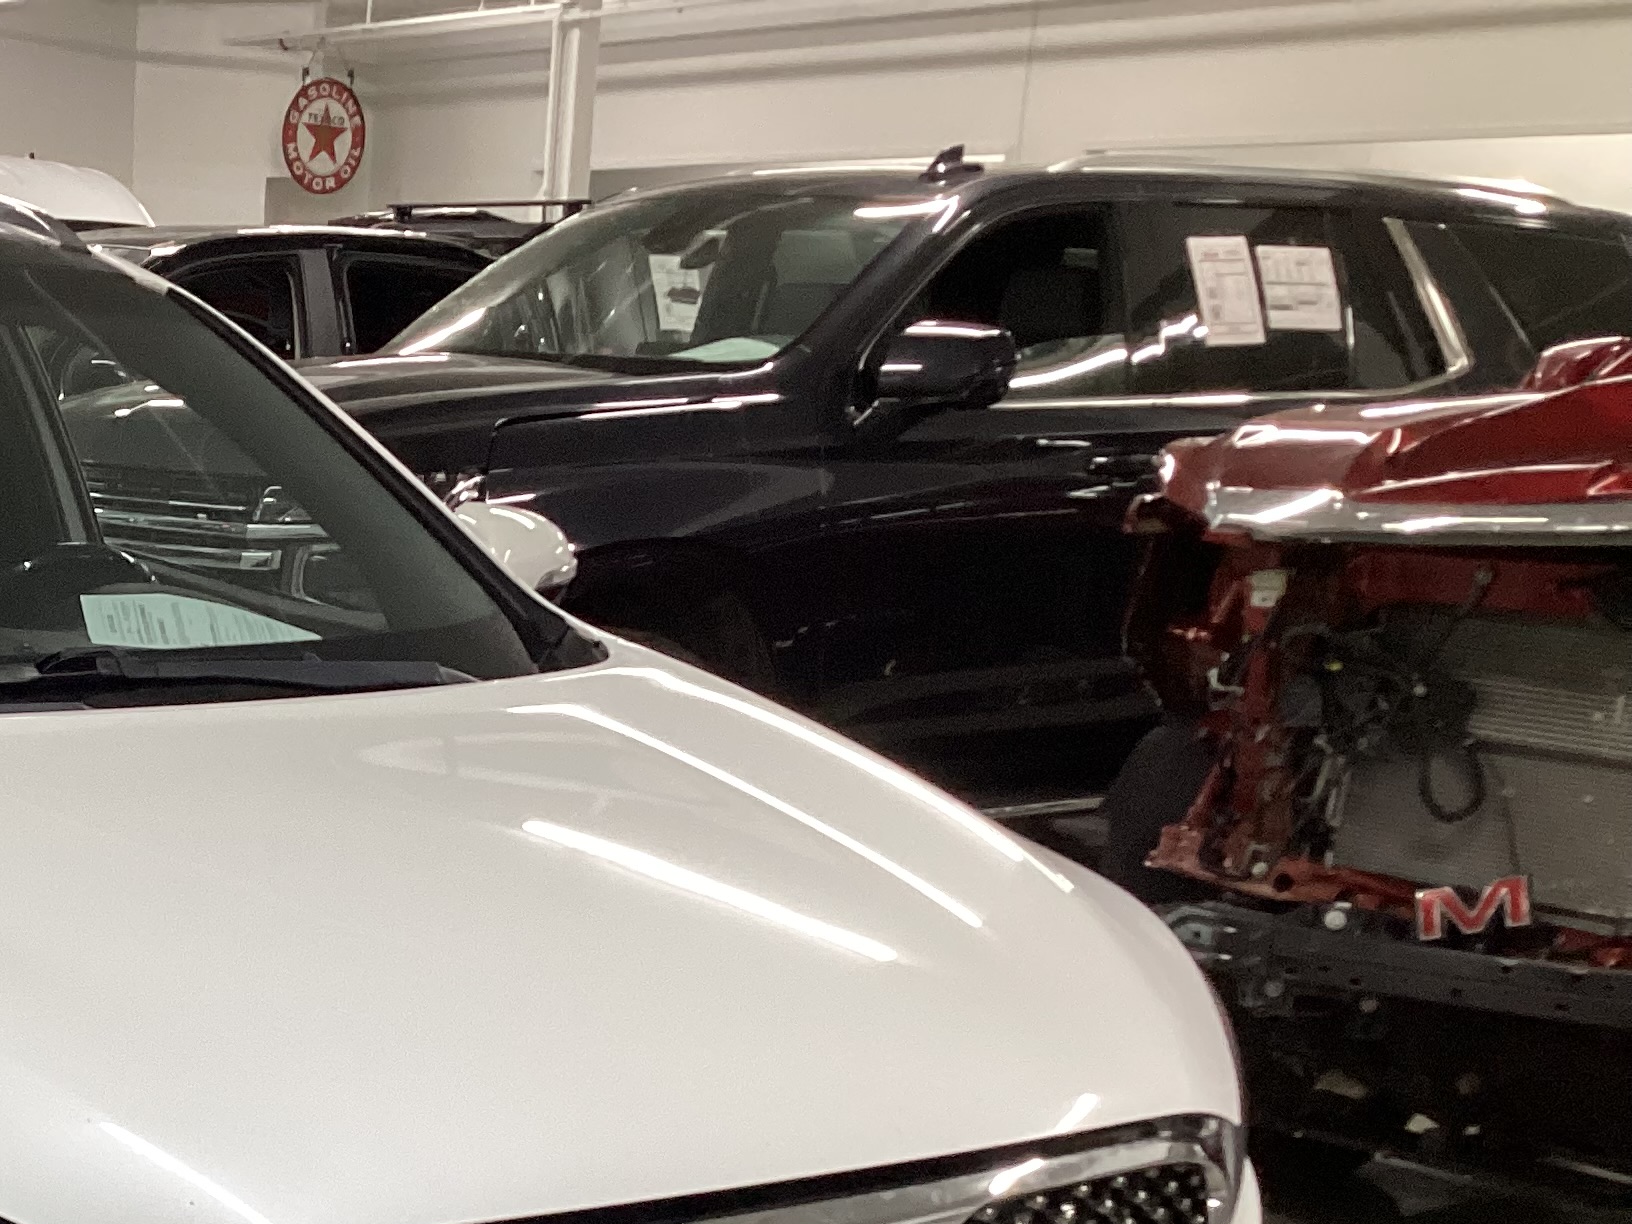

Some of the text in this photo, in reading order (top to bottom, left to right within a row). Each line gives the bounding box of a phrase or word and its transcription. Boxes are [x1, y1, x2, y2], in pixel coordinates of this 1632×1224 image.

[289, 82, 362, 127] GASOLINE
[308, 112, 345, 125] TECO
[287, 142, 361, 190] MOTOR OIL
[1415, 875, 1531, 941] M
